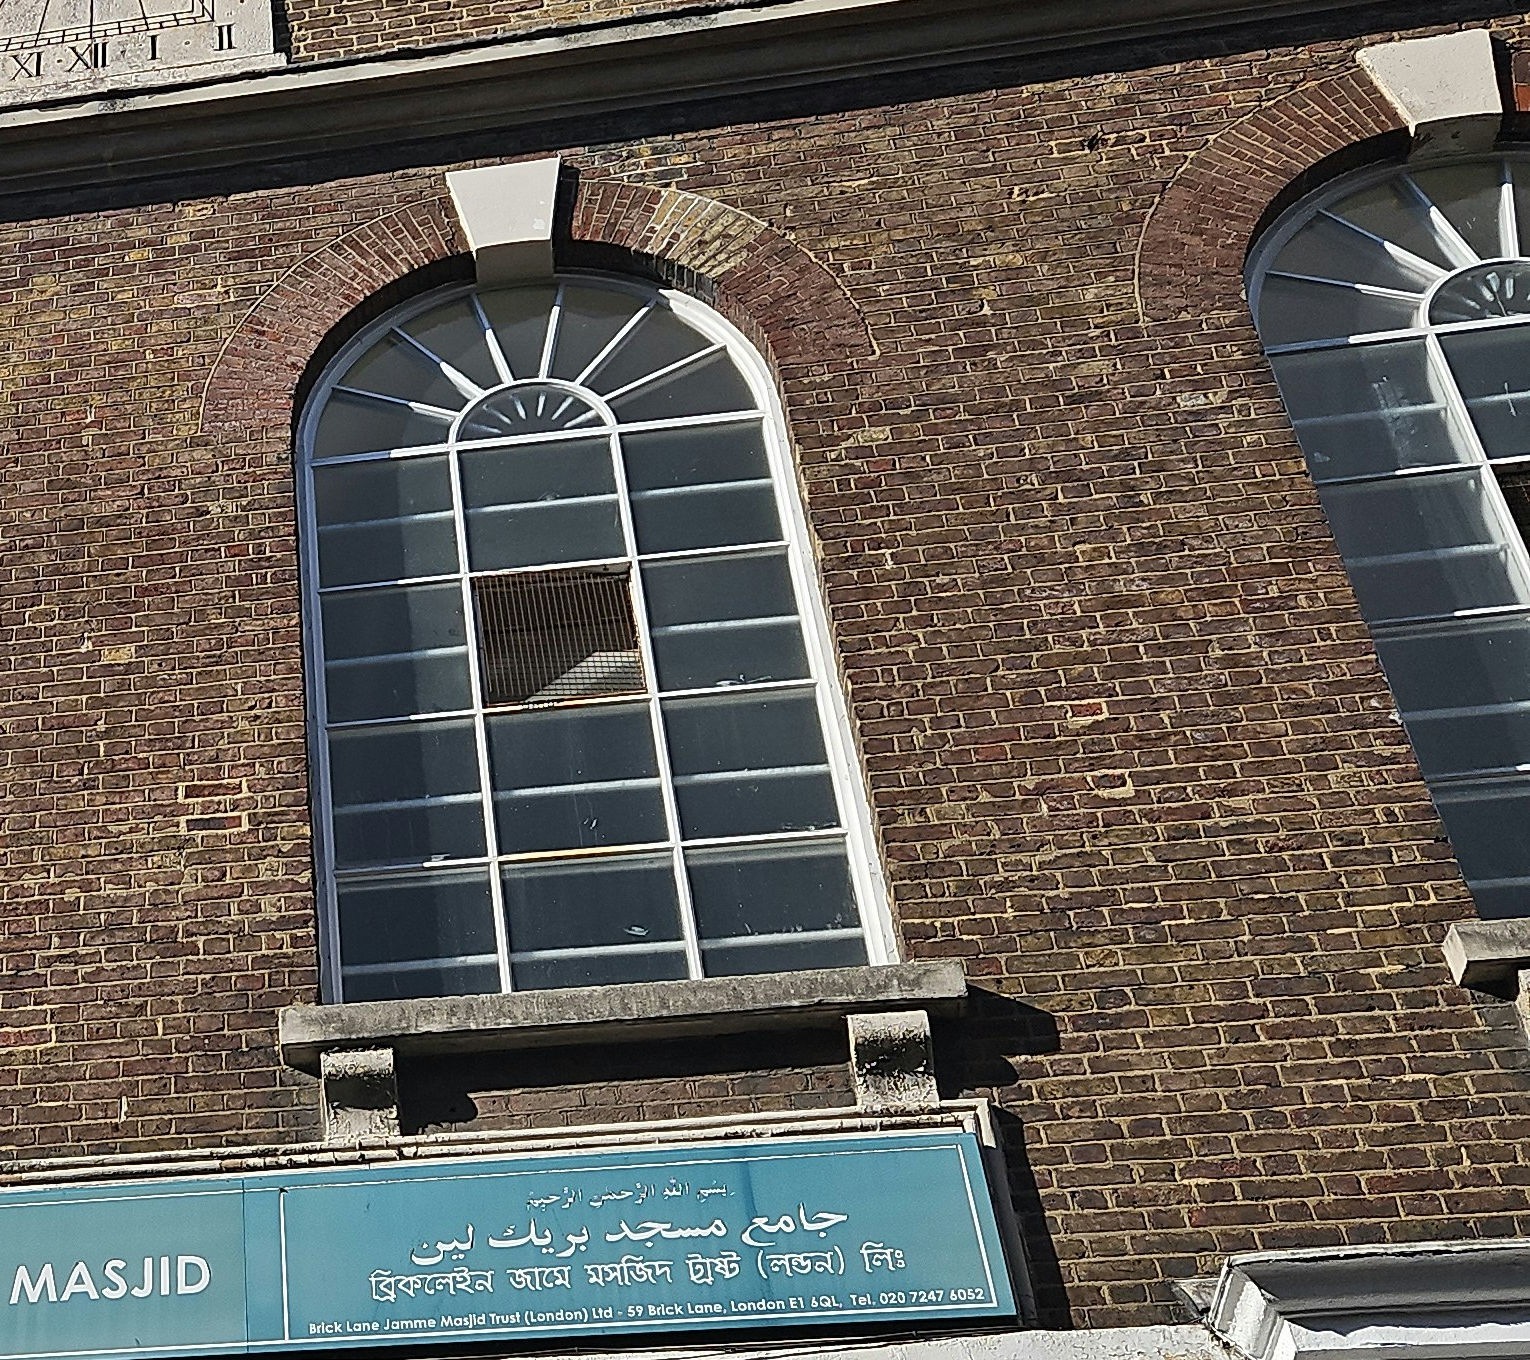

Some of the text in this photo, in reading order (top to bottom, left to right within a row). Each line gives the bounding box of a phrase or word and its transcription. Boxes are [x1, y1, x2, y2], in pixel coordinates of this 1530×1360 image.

[147, 33, 161, 61] I
[213, 23, 237, 51] II
[9, 51, 44, 82] XI
[64, 42, 109, 72] XII
[605, 1215, 727, 1248] مسجد
[741, 1202, 849, 1247] جامع
[410, 1223, 475, 1265] لين
[8, 1254, 213, 1306] MASJID
[506, 1264, 572, 1291] জামে
[583, 1254, 674, 1287] মসজিদ
[308, 1321, 343, 1335] Brick
[346, 1319, 379, 1332] Lane
[382, 1317, 437, 1331] Jamme
[440, 1313, 486, 1329] Masjid
[489, 1311, 521, 1325] Trust
[524, 1306, 589, 1325] (London)
[592, 1306, 613, 1320] Ltd
[627, 1304, 646, 1318] 59
[648, 1303, 684, 1317] Brick
[687, 1301, 727, 1315] Lane,
[730, 1297, 785, 1312] London
[789, 1296, 806, 1309] E1
[811, 1296, 843, 1309] 6QL,
[849, 1293, 877, 1307] Tel.
[879, 1291, 906, 1305] 020
[909, 1289, 945, 1303] 7247
[949, 1287, 986, 1301] 6052
